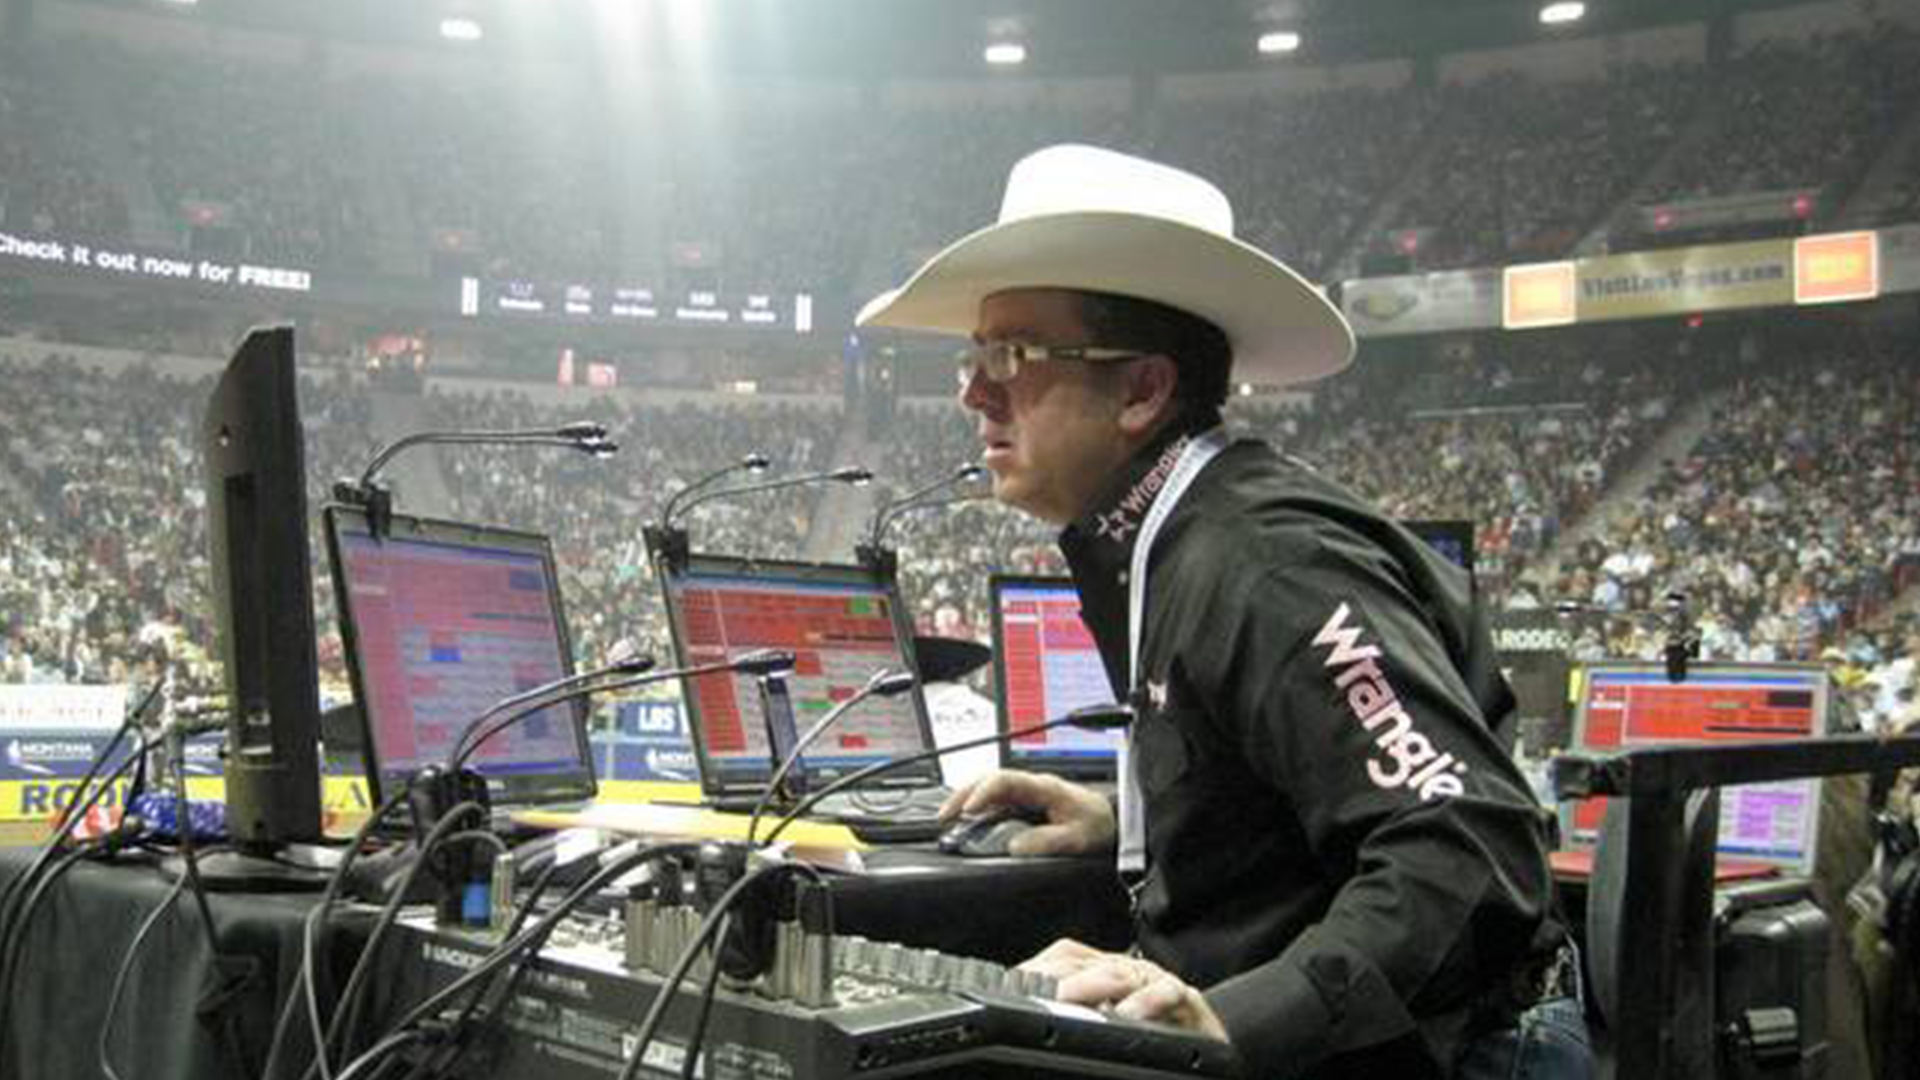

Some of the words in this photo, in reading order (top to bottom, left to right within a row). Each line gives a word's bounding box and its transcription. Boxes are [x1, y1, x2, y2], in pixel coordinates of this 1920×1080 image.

[73, 244, 90, 266] it
[96, 251, 137, 272] out
[143, 257, 192, 279] now
[199, 261, 234, 284] for
[1120, 434, 1190, 514] Wrangle
[1311, 602, 1468, 801] Wrangle
